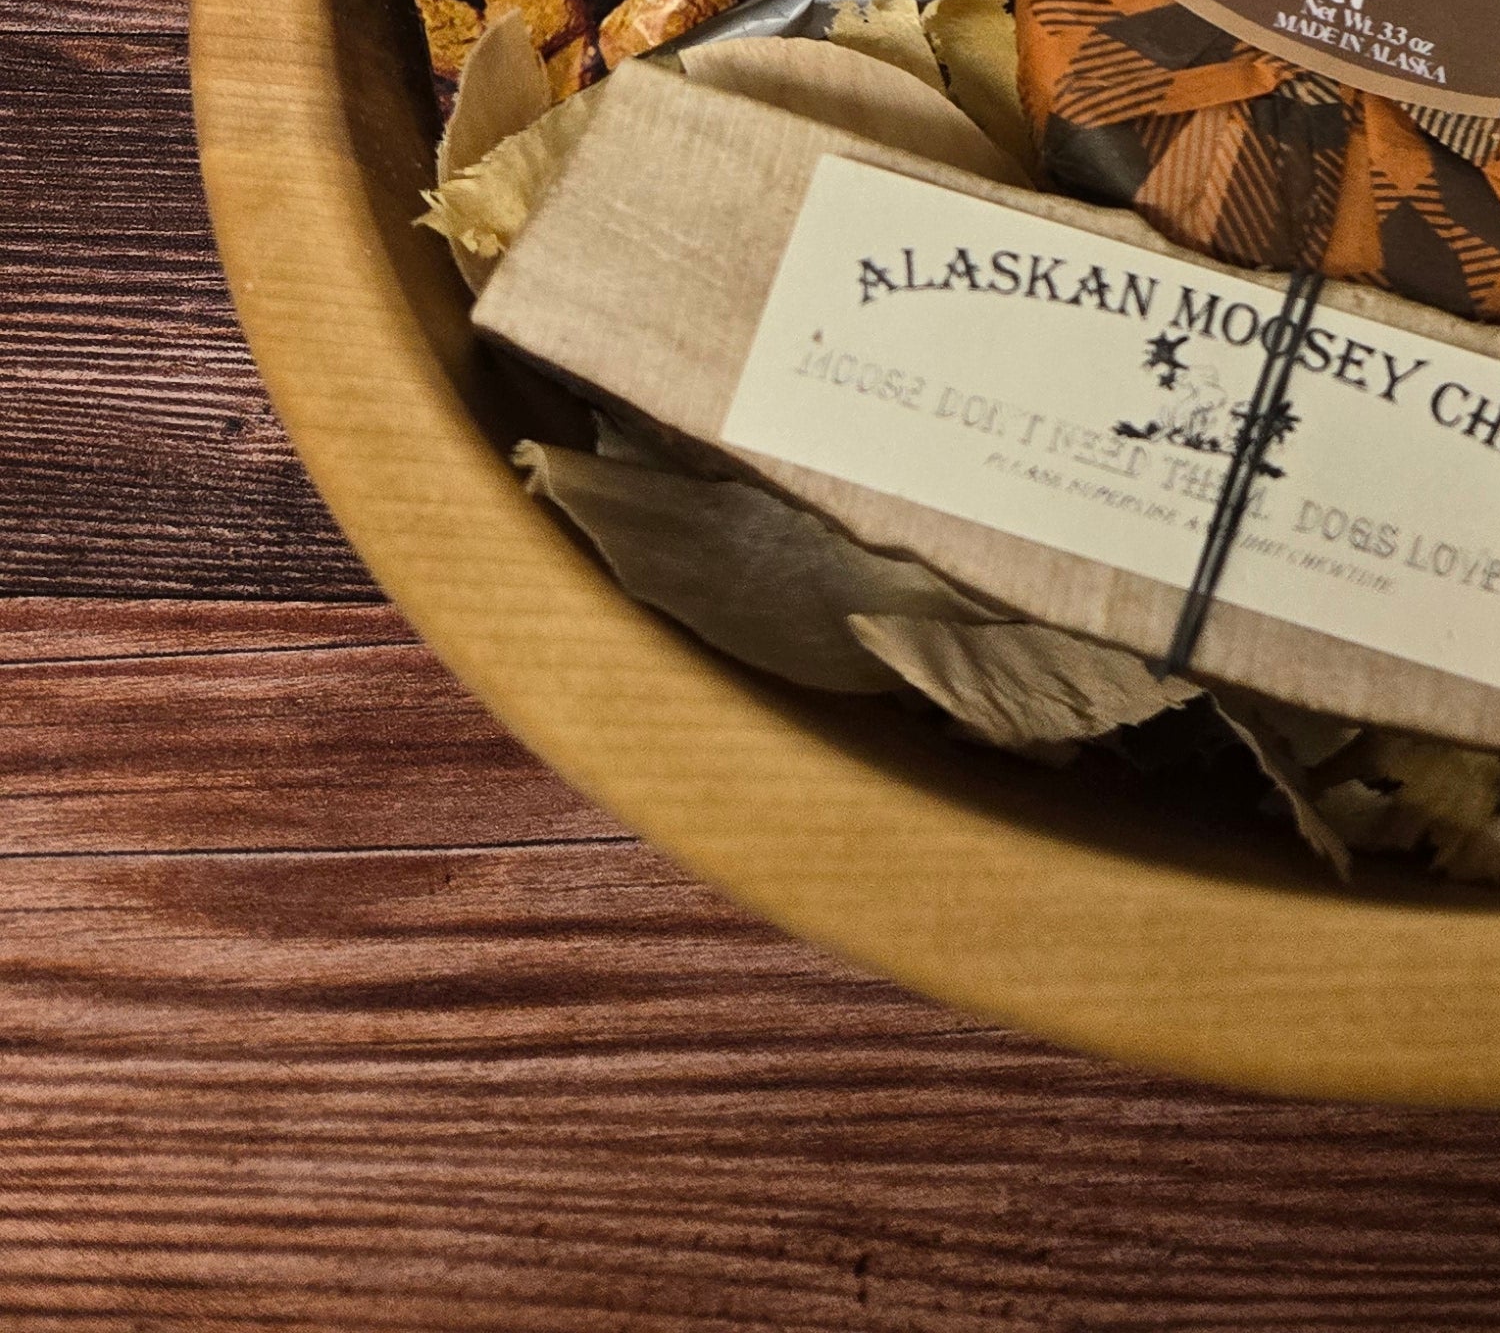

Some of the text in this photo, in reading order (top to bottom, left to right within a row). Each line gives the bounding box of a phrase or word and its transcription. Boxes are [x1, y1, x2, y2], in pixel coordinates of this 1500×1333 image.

[1273, 12, 1446, 83] MADE IN ALASKA
[1377, 22, 1408, 45] 3.3
[1408, 37, 1435, 56] oz
[856, 246, 1159, 328] ALASKAN
[1293, 499, 1399, 559] DOGS
